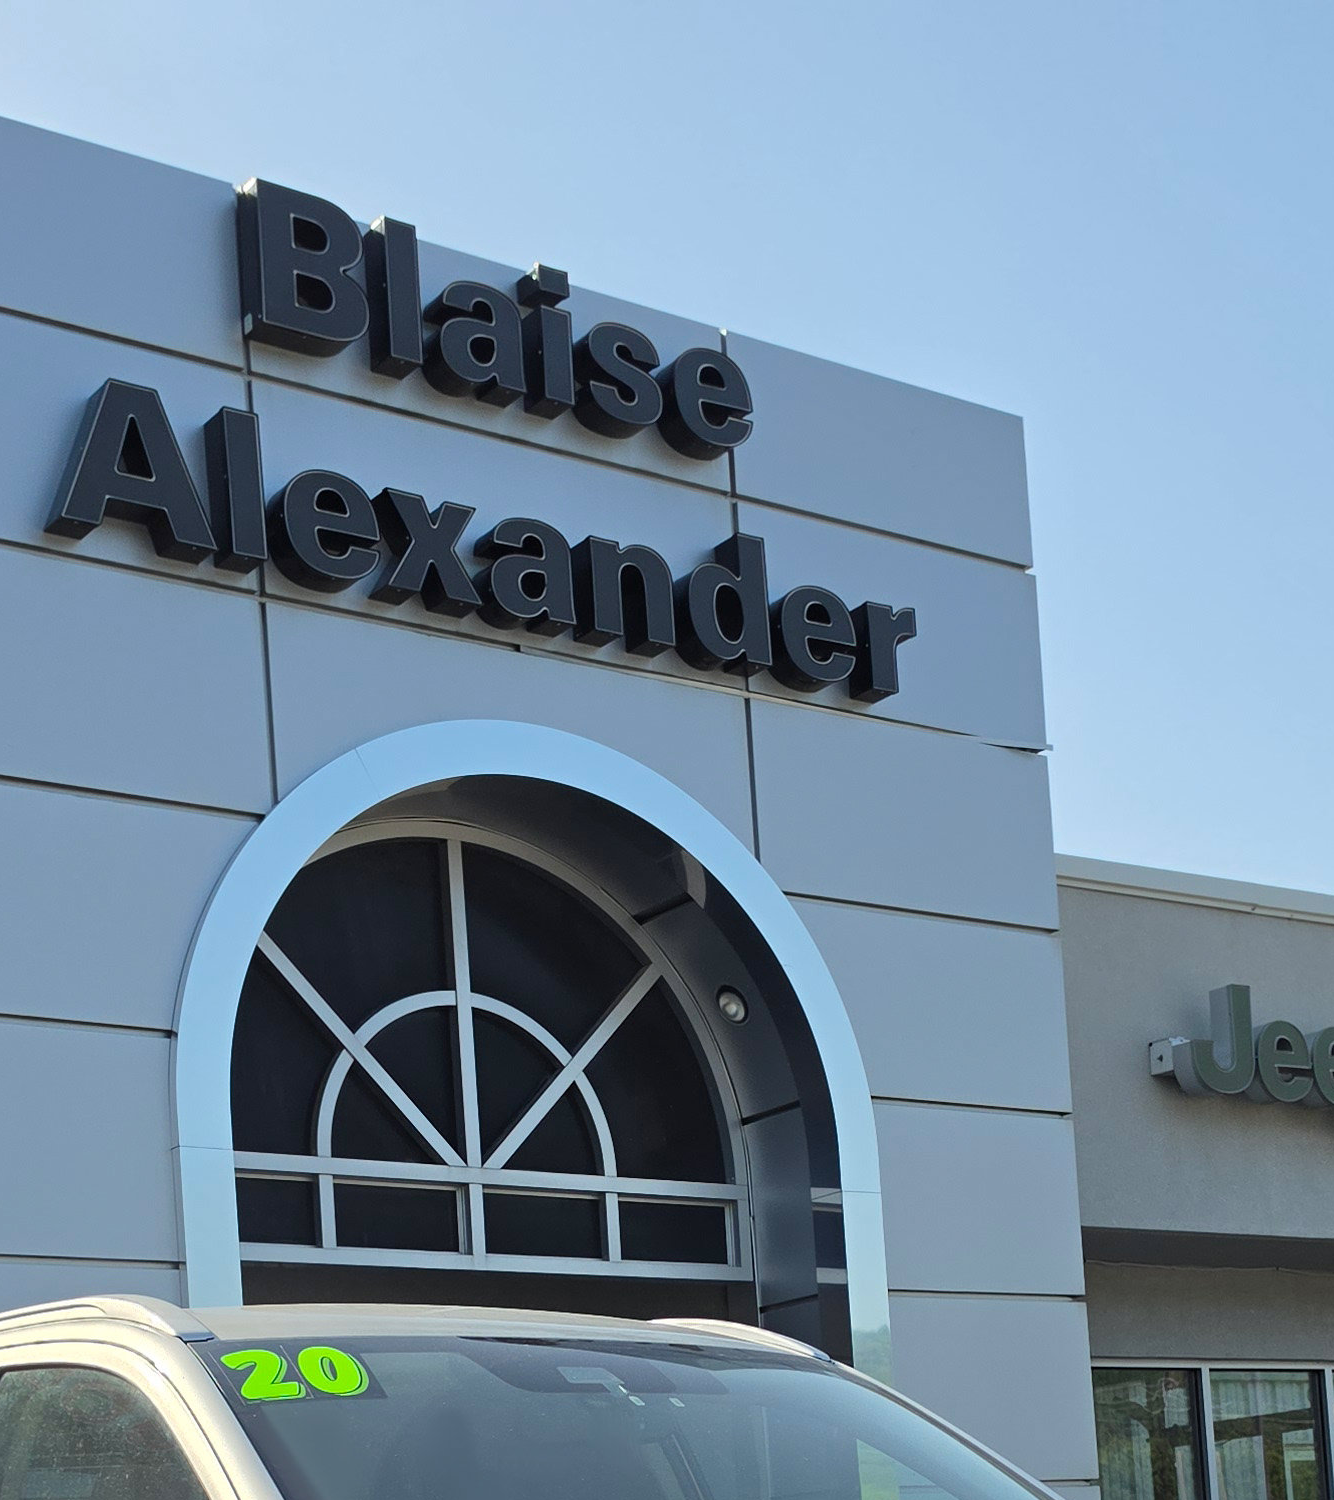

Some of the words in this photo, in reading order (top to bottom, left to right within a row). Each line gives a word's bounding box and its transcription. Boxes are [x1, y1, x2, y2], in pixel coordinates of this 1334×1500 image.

[236, 177, 754, 461] Blaise
[44, 377, 917, 704] Alexander
[220, 1346, 369, 1402] 20
